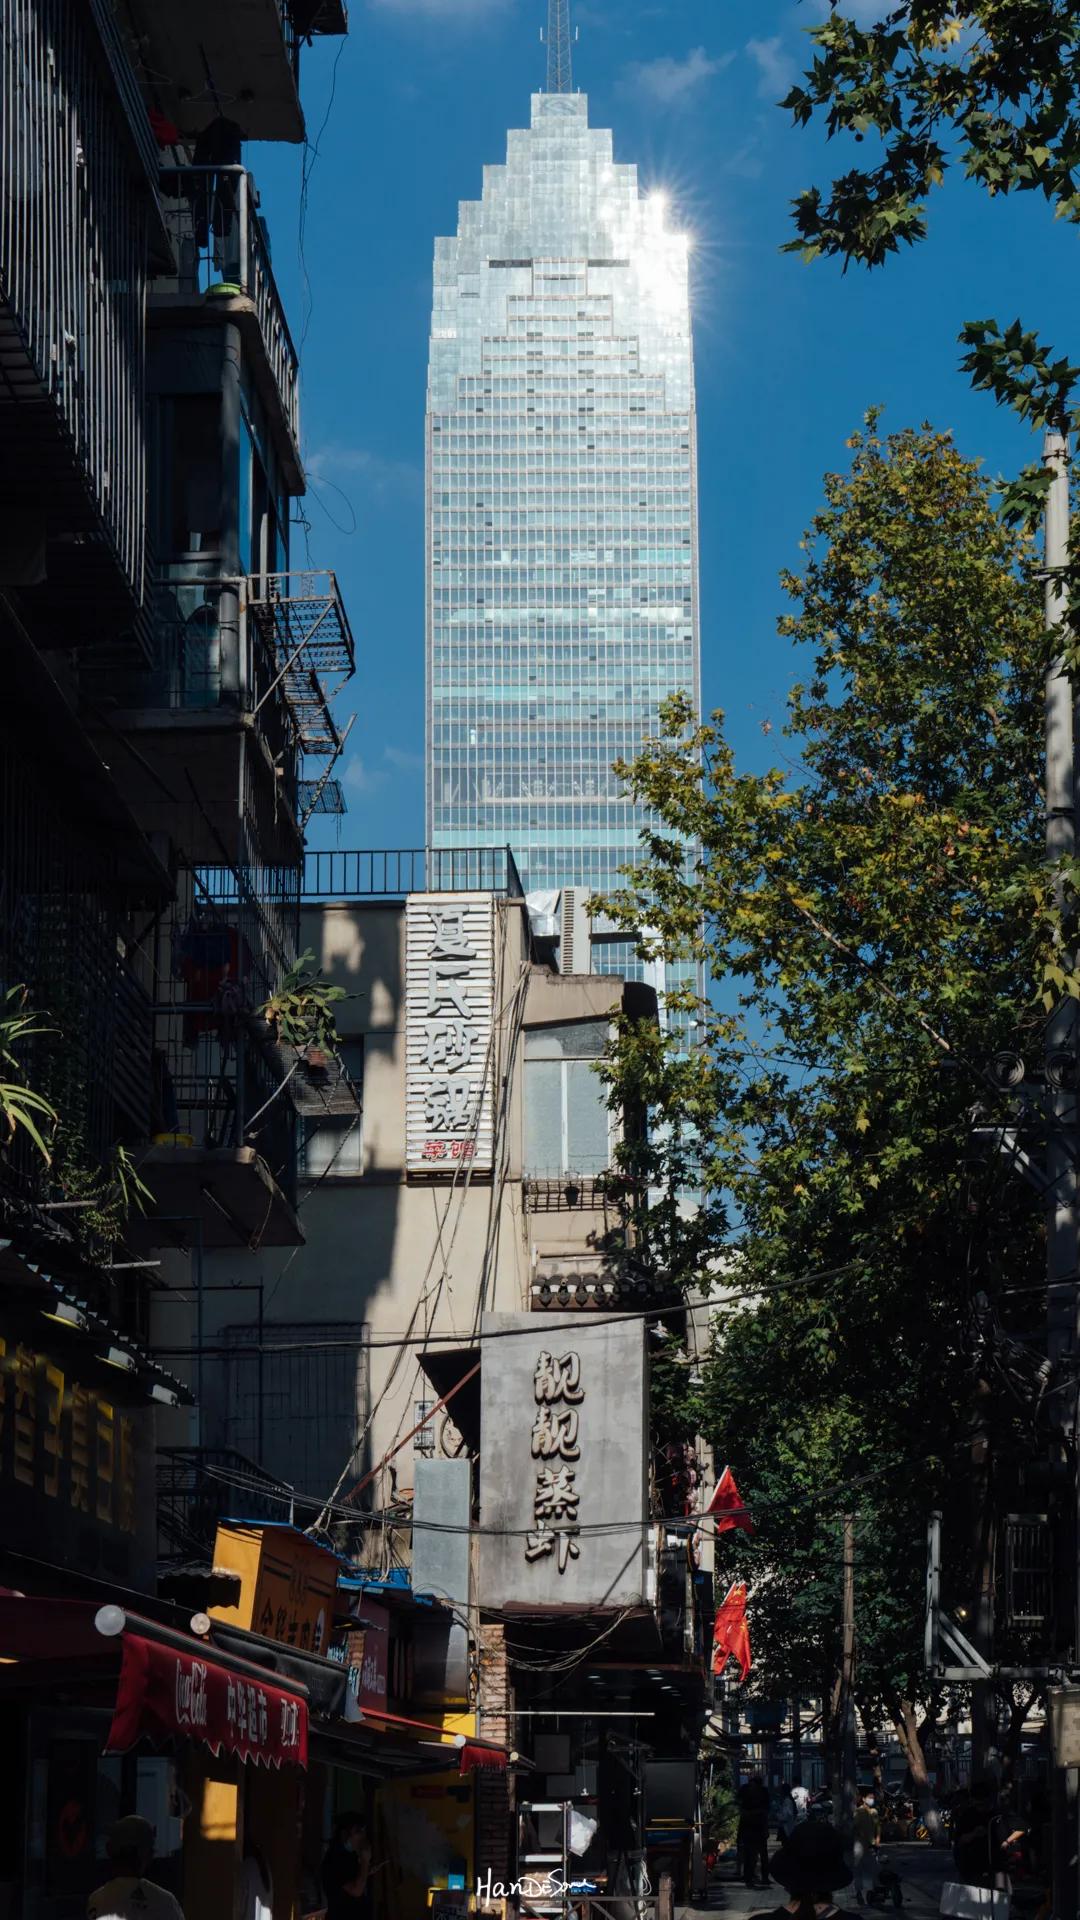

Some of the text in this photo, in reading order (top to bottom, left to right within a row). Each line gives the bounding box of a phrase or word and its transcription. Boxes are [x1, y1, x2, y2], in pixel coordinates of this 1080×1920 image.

[421, 903, 478, 1132] 夏氏砂锅
[525, 1351, 584, 1575] 靓靓蒸虾
